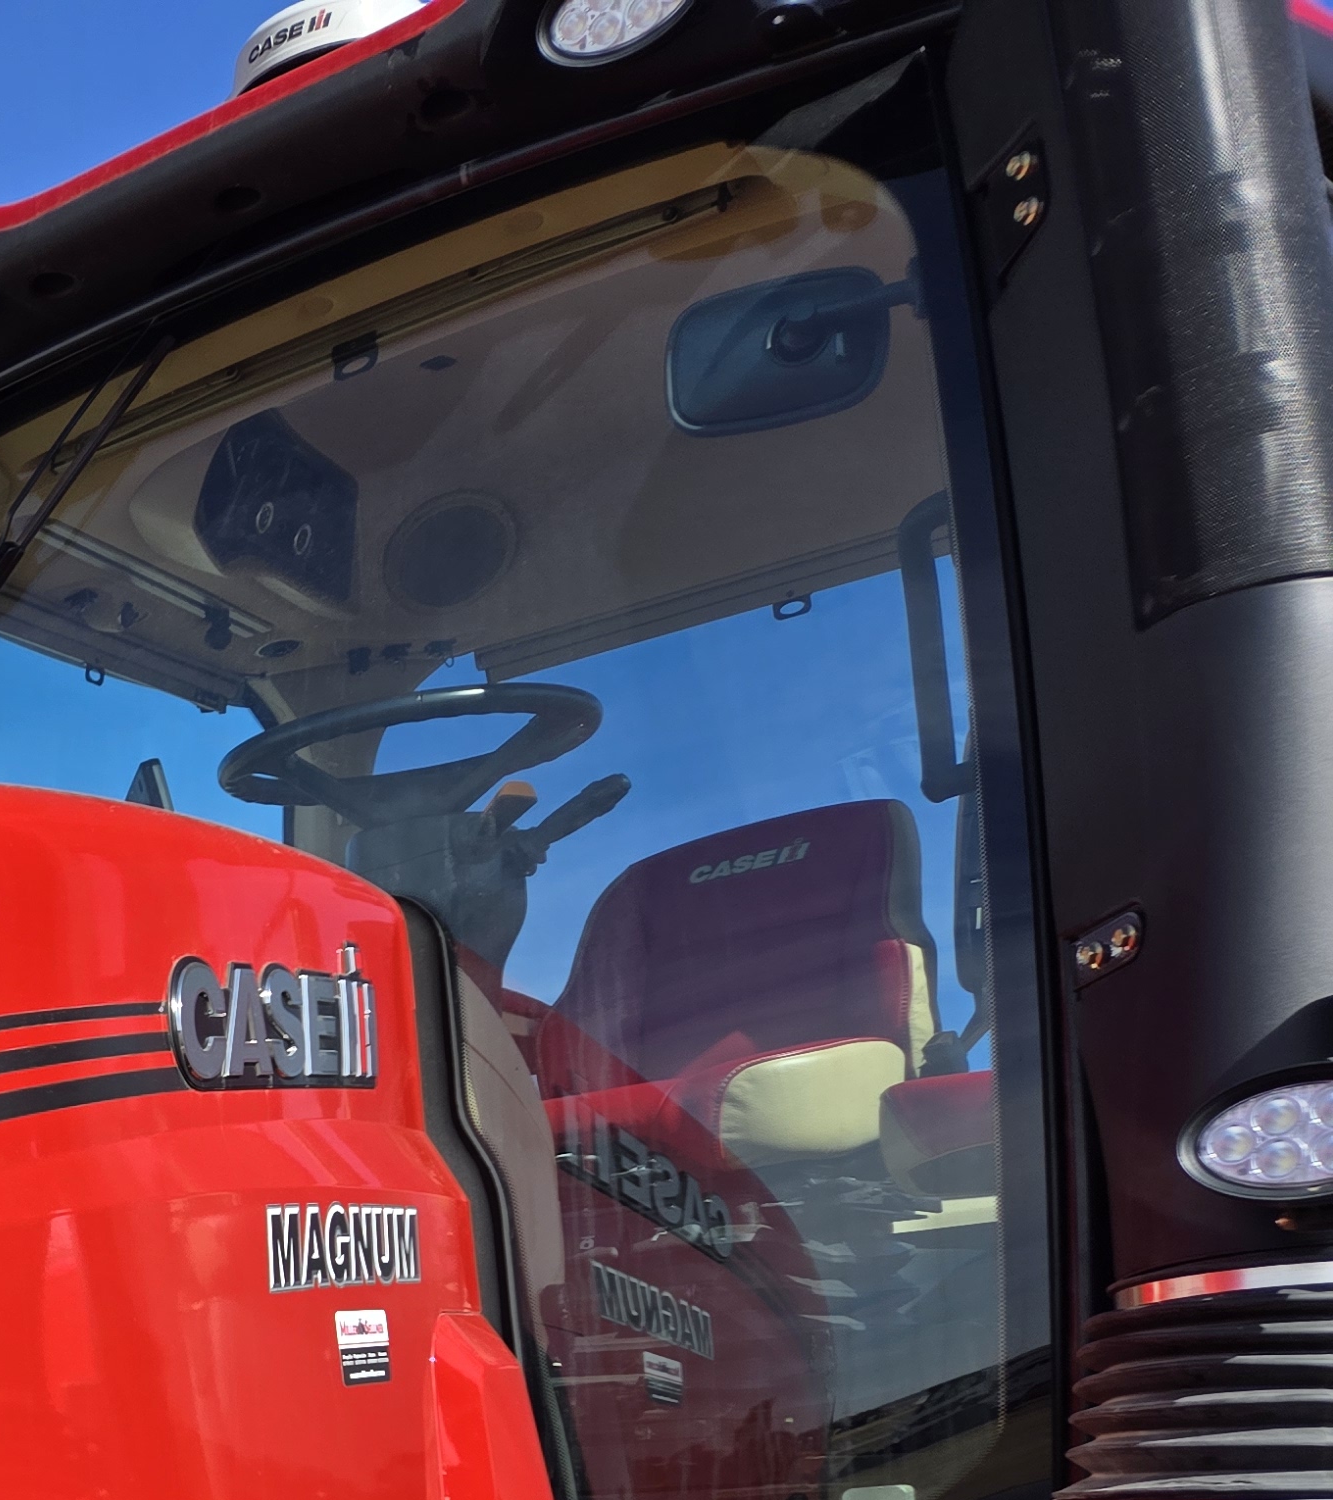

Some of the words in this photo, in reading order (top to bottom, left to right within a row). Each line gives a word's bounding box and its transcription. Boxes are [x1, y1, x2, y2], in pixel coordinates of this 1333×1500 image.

[248, 19, 305, 64] CASE
[689, 848, 778, 884] CASE
[168, 956, 339, 1088] CASE
[265, 1200, 422, 1294] MAGNUM
